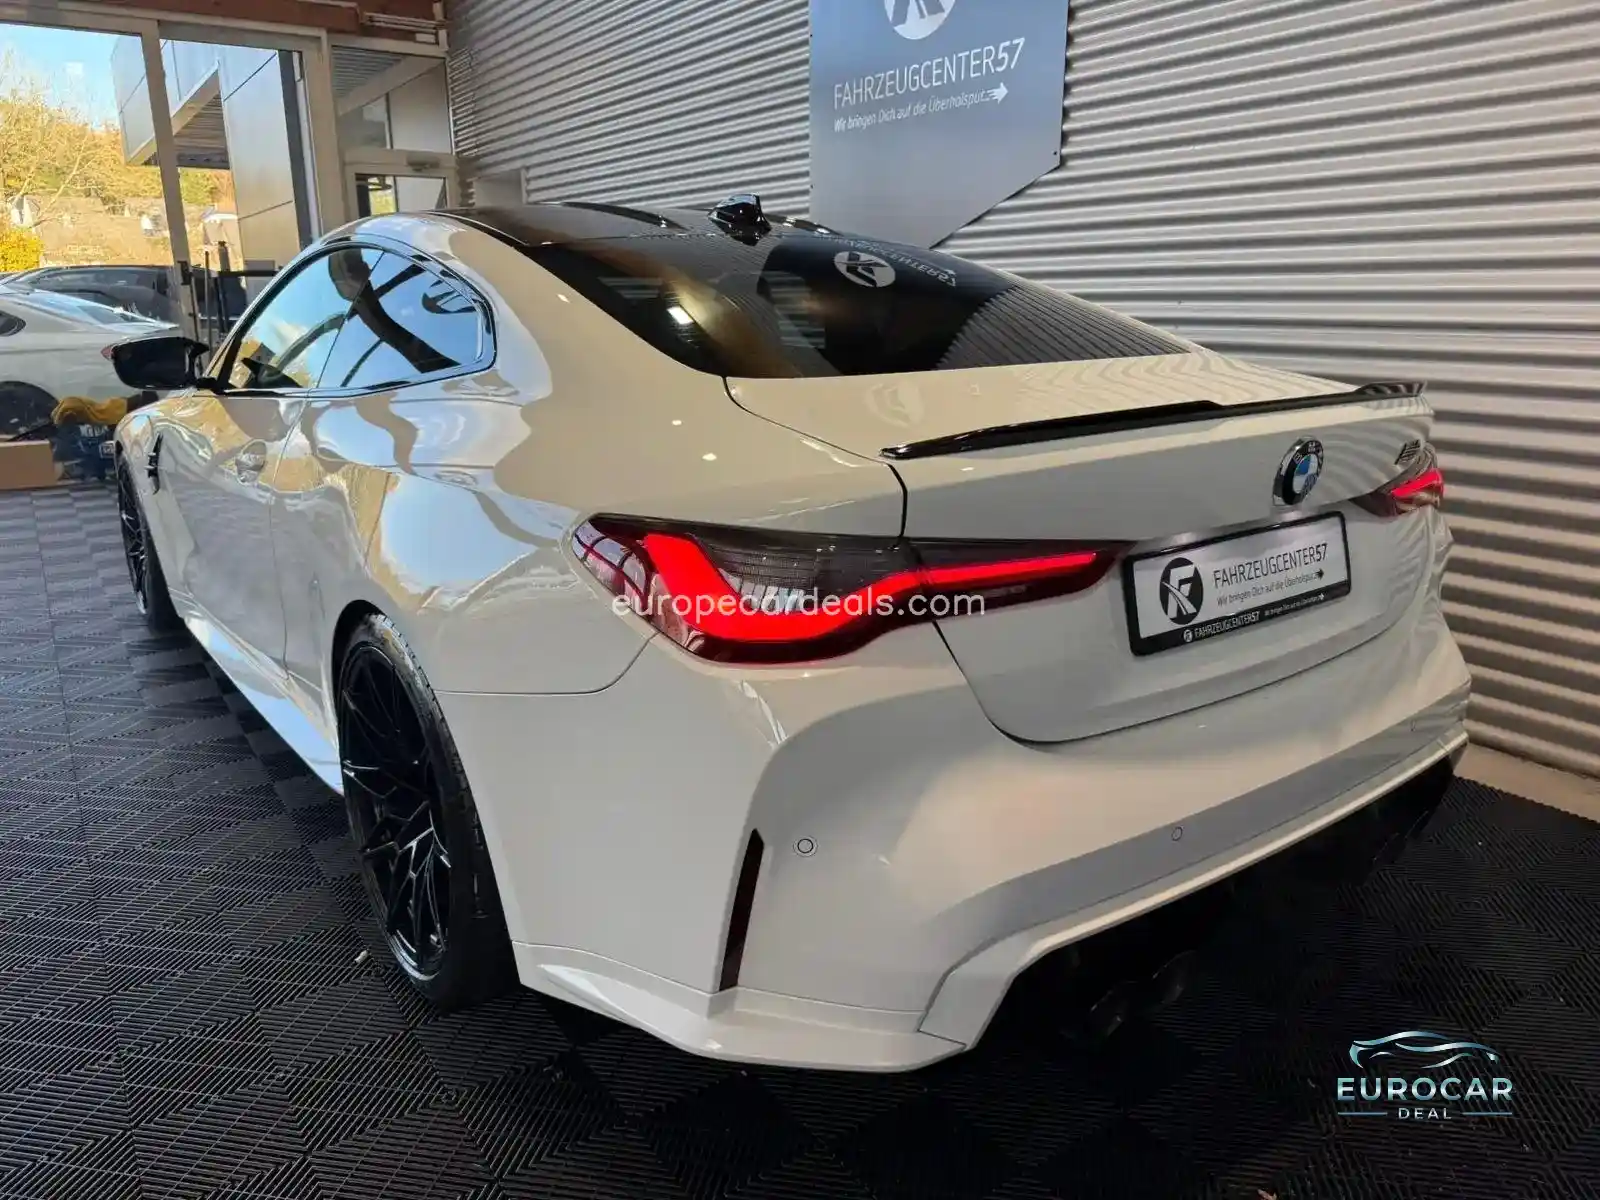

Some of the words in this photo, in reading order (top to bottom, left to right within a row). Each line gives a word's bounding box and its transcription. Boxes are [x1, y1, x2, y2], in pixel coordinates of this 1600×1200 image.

[834, 37, 1025, 110] FAHRZEUGCENTER57
[834, 118, 846, 132] Wir
[847, 114, 876, 130] bringen
[878, 107, 896, 123] Dich
[897, 103, 911, 119] auf
[913, 101, 927, 116] die
[1213, 543, 1327, 588] FAHRZEUGCENTER57
[1194, 611, 1260, 638] FAHRZEUGCENTER57
